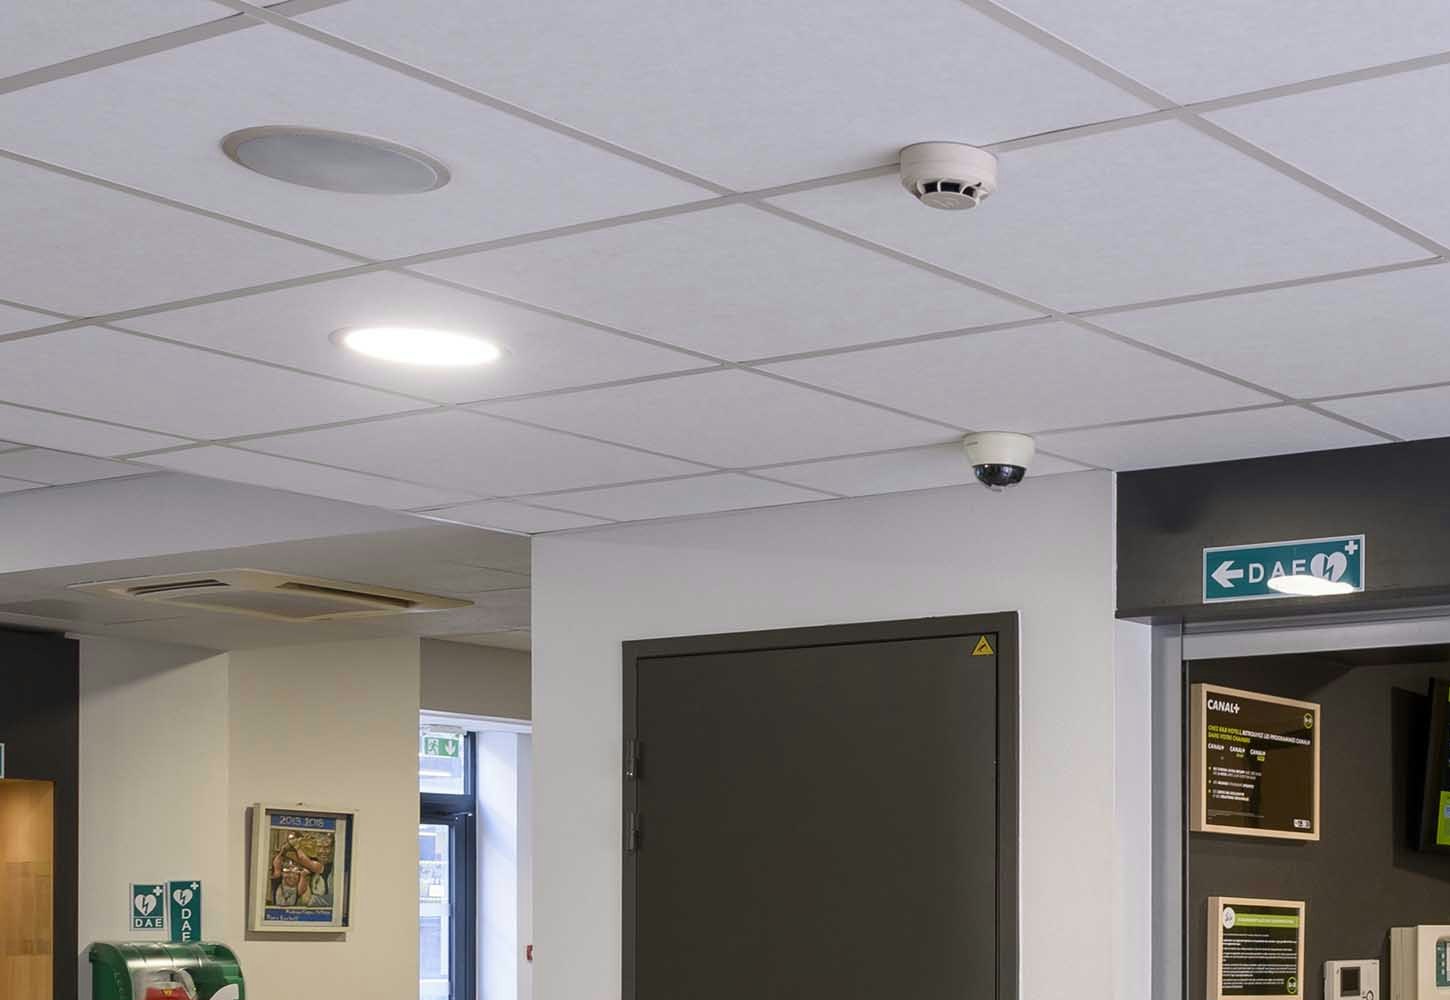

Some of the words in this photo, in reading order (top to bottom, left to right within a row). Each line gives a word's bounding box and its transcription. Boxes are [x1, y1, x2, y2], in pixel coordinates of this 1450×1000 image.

[1248, 559, 1306, 584] DAE
[1207, 699, 1241, 714] CANAL+
[135, 918, 163, 928] DAE
